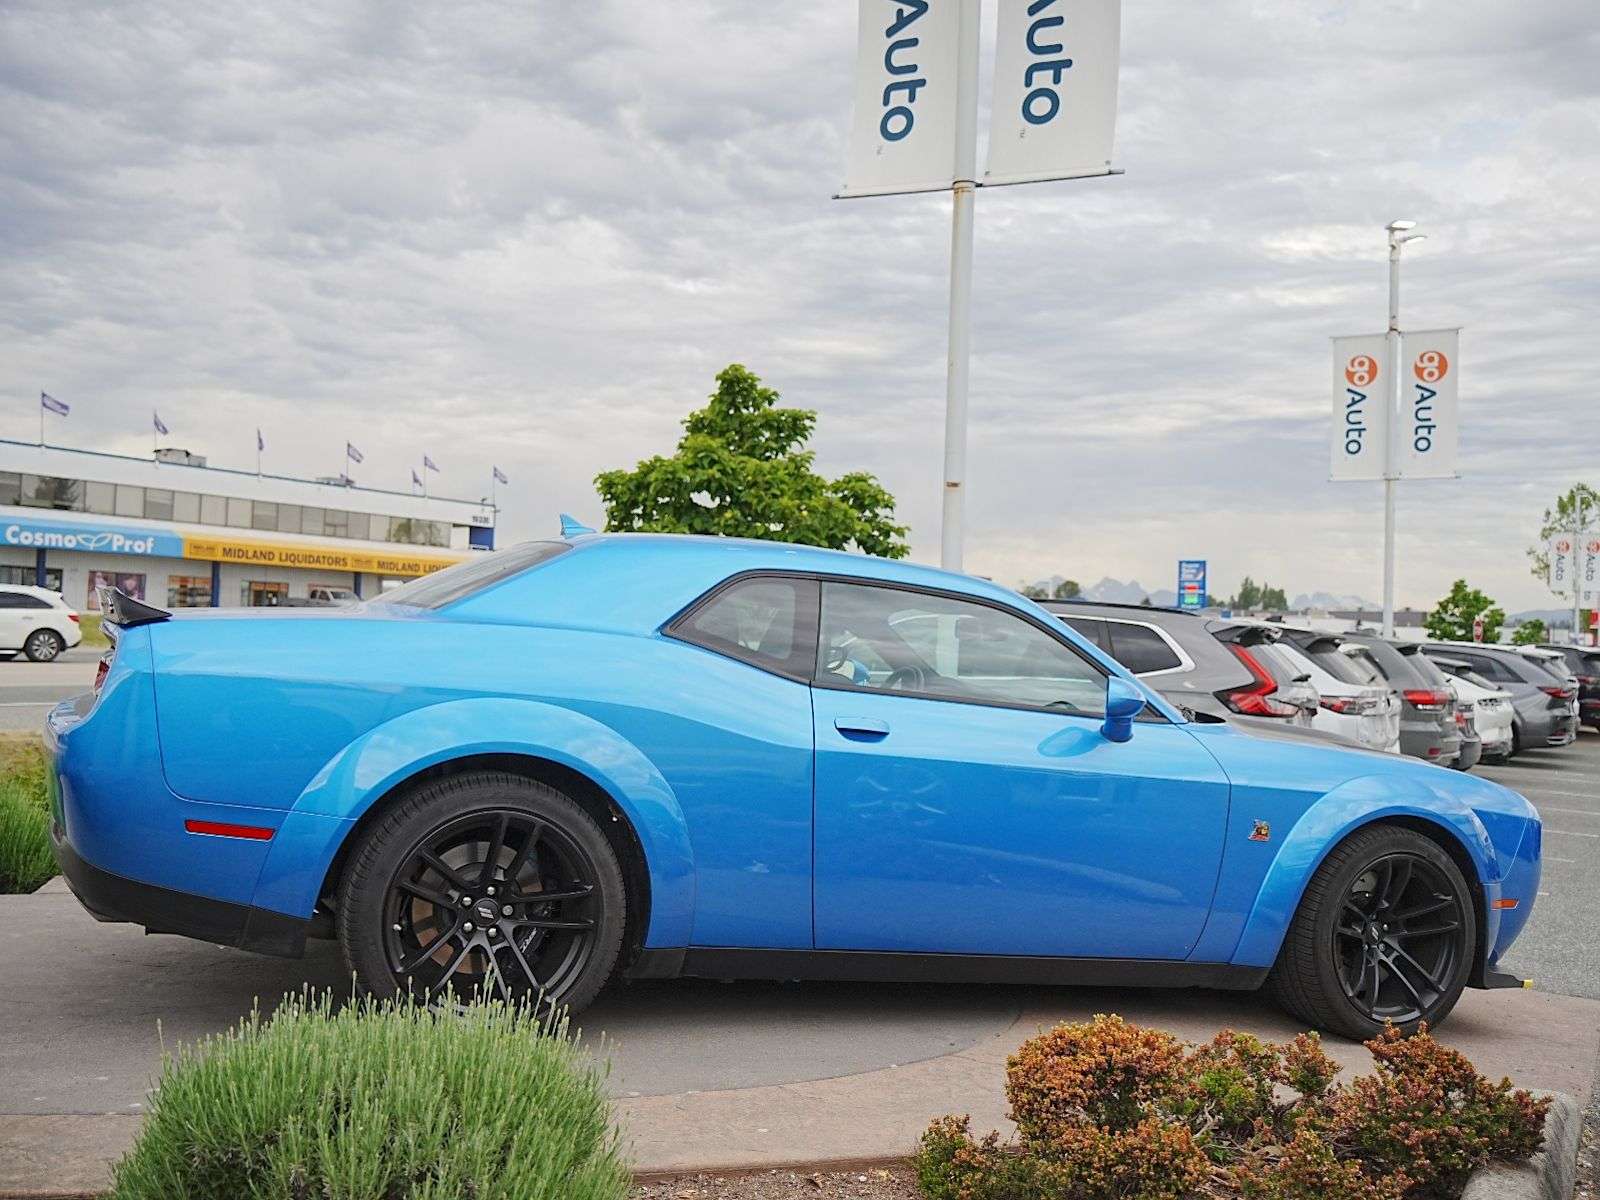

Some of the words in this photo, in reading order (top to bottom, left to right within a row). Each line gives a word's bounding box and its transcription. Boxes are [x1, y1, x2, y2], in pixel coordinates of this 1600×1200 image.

[879, 0, 929, 142] Auto
[1345, 388, 1367, 455] Auto
[1414, 384, 1437, 452] Auto
[5, 525, 77, 548] Cosmo
[111, 534, 155, 554] Prof
[222, 547, 275, 562] MIDLAND
[279, 551, 348, 567] LIQUIDATORS
[377, 560, 420, 572] MIDLAND
[1555, 555, 1564, 580] Auto
[1586, 555, 1595, 580] Auto
